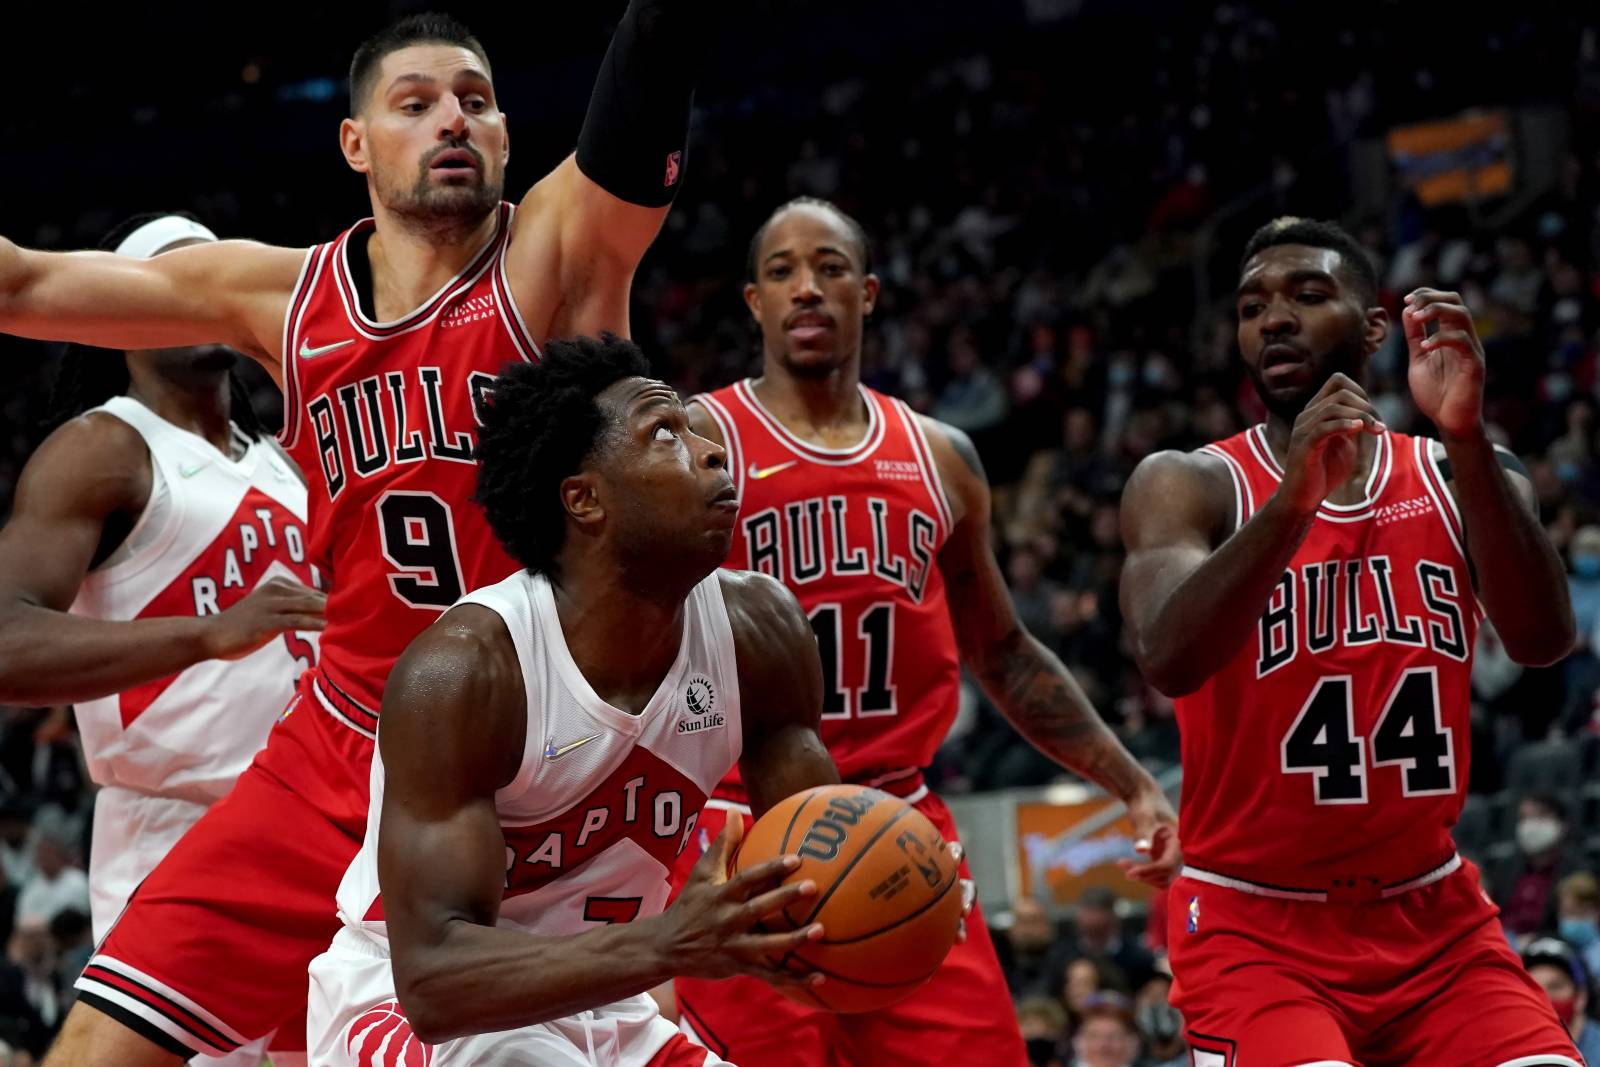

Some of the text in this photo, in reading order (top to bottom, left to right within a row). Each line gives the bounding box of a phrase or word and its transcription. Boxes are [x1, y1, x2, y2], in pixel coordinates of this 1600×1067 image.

[441, 309, 495, 328] EYEWEAR
[375, 490, 467, 611] 9
[742, 496, 938, 605] BULLS
[807, 602, 898, 719] 11
[1256, 555, 1469, 680] BULLS
[679, 713, 724, 733] Sun Life
[1280, 666, 1457, 805] 44
[797, 789, 888, 862] Wils
